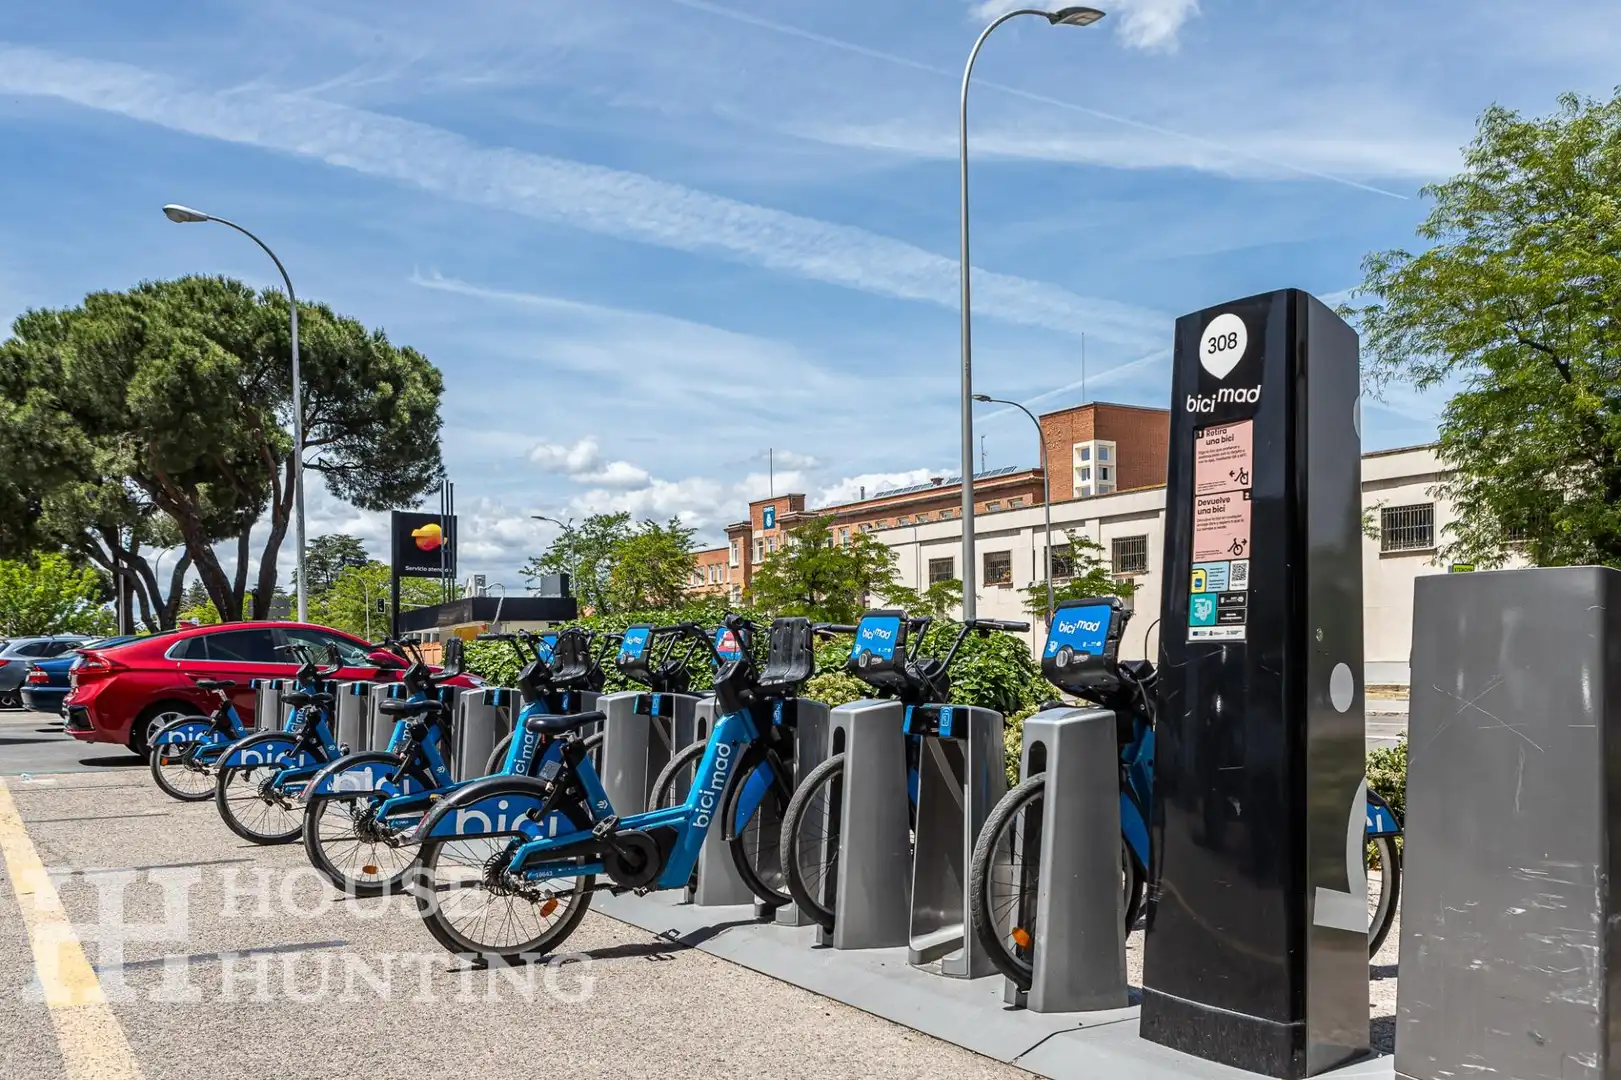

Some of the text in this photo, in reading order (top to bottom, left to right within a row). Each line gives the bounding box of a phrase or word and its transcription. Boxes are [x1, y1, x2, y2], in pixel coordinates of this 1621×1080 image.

[1207, 331, 1238, 355] 308
[1206, 428, 1228, 437] Retira
[1205, 433, 1235, 446] una bici
[1197, 496, 1231, 507] Devuelve
[1197, 504, 1226, 515] una bici
